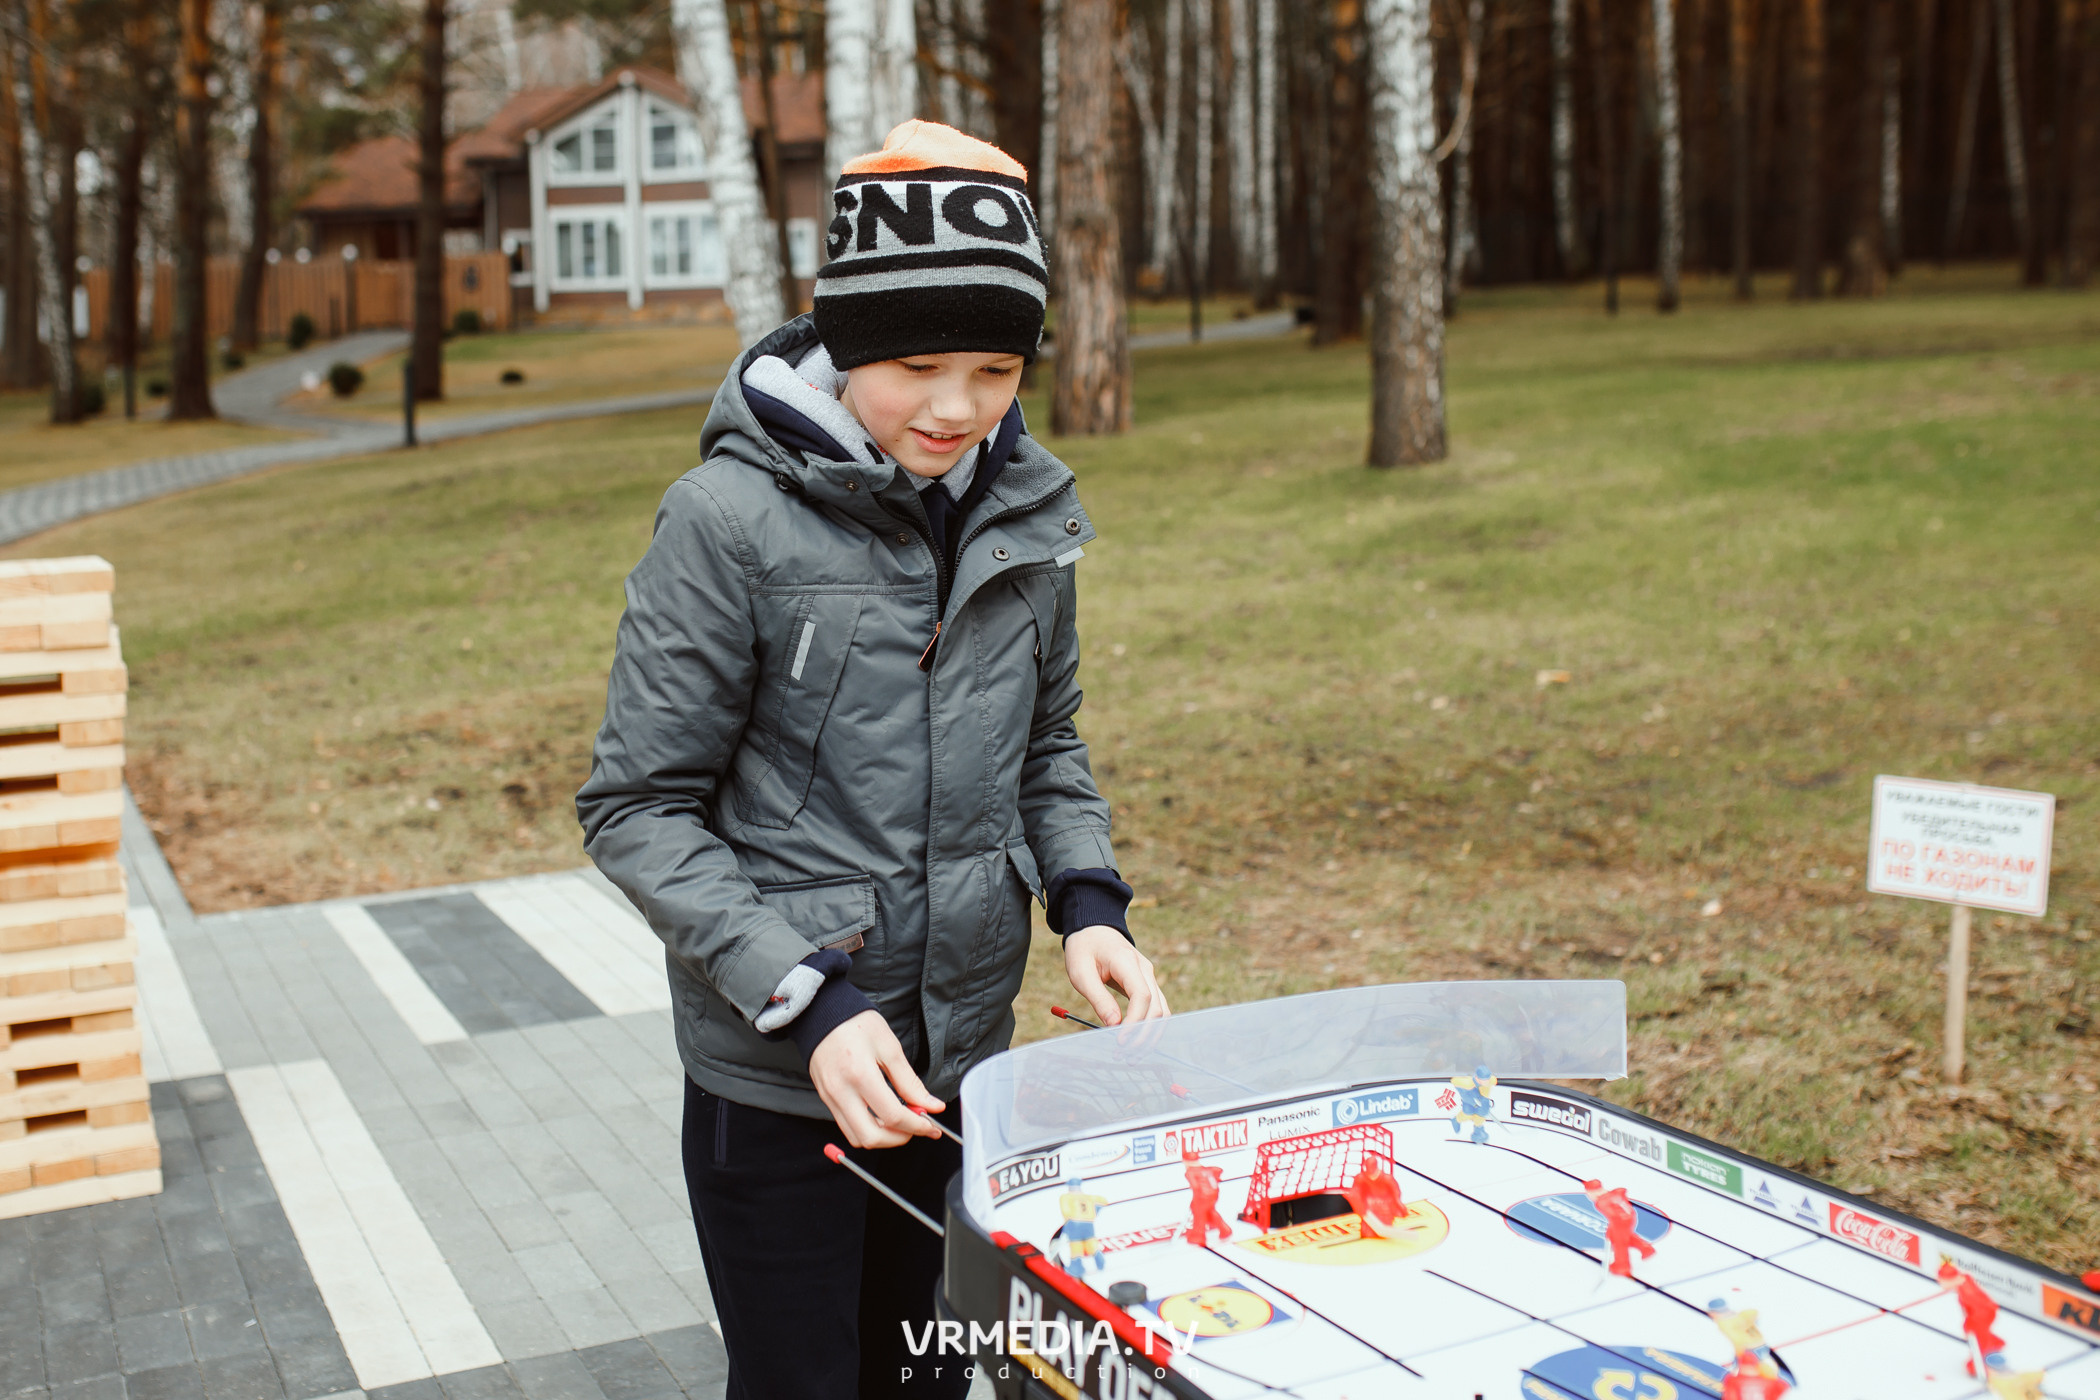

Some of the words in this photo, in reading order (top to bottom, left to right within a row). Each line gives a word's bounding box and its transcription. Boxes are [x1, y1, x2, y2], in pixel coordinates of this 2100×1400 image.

[827, 182, 1048, 262] SNO
[1882, 839, 1916, 861] ПО
[1921, 843, 2036, 875] ГАЗОНАМ
[1886, 862, 1915, 881] НЕ
[1258, 1106, 1320, 1127] Panasonic
[1360, 1093, 1411, 1117] Lindab
[1512, 1099, 1591, 1133] swedol
[1182, 1120, 1247, 1154] TAKTIK
[1598, 1117, 1662, 1162] Cowab
